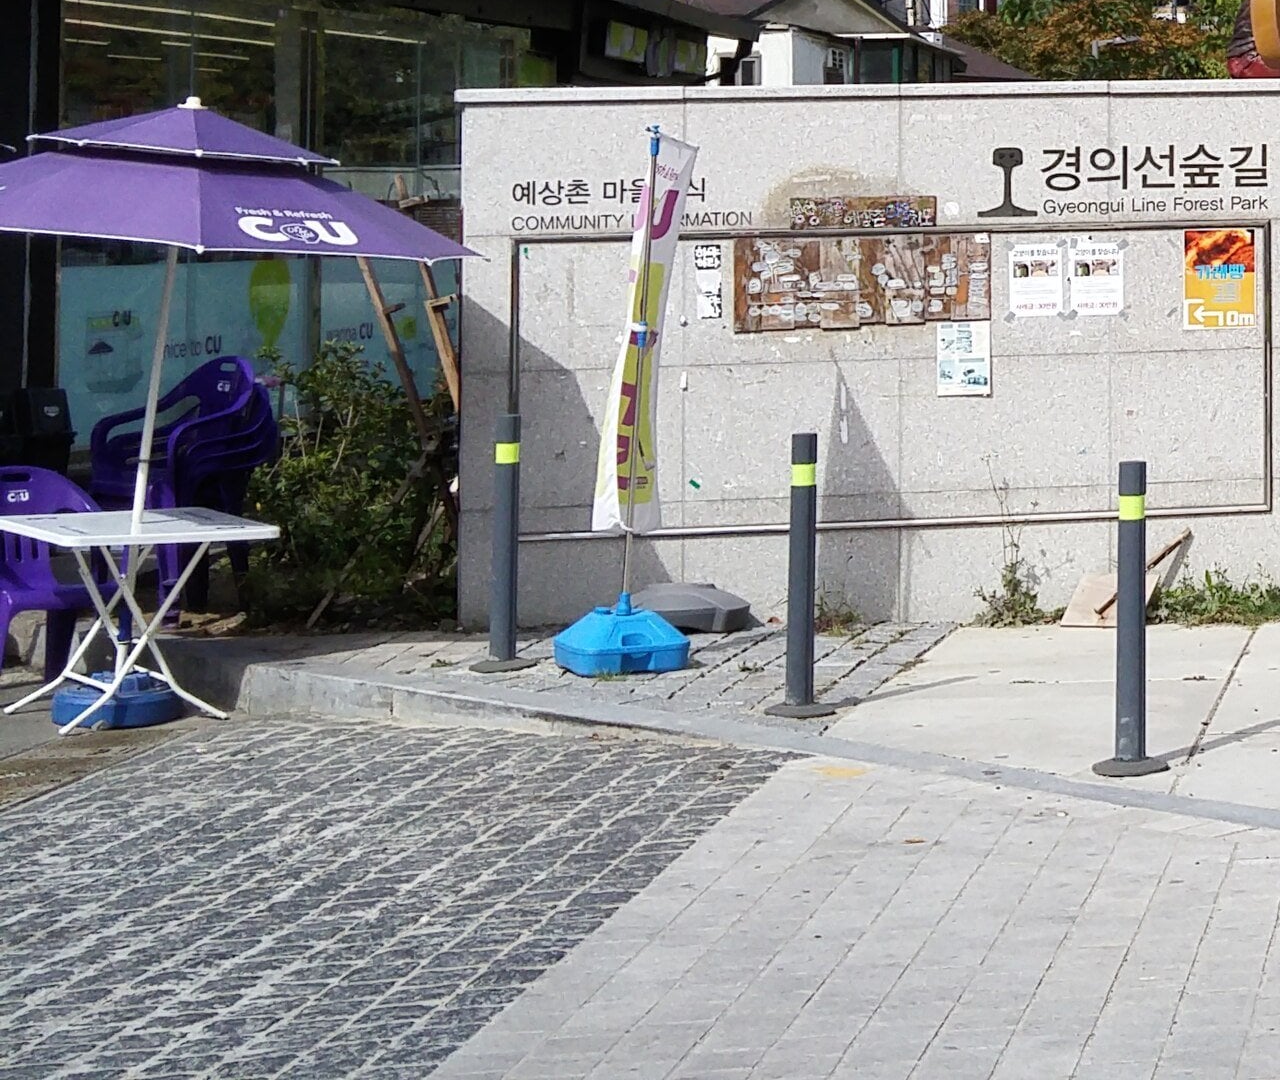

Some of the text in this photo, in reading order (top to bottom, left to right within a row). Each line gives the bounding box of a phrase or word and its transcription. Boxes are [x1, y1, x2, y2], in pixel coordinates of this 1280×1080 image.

[1041, 143, 1268, 191] 경의선숲길
[512, 177, 706, 205] 예상촌 마을식
[235, 206, 271, 217] Fresh
[284, 210, 333, 220] Refresh
[1043, 195, 1268, 215] Gyeongui Line Forest Park
[238, 216, 358, 246] CU
[512, 211, 752, 231] COMMUNITY IMATION
[360, 322, 374, 339] CU
[205, 334, 222, 354] CU
[7, 492, 30, 503] CU
